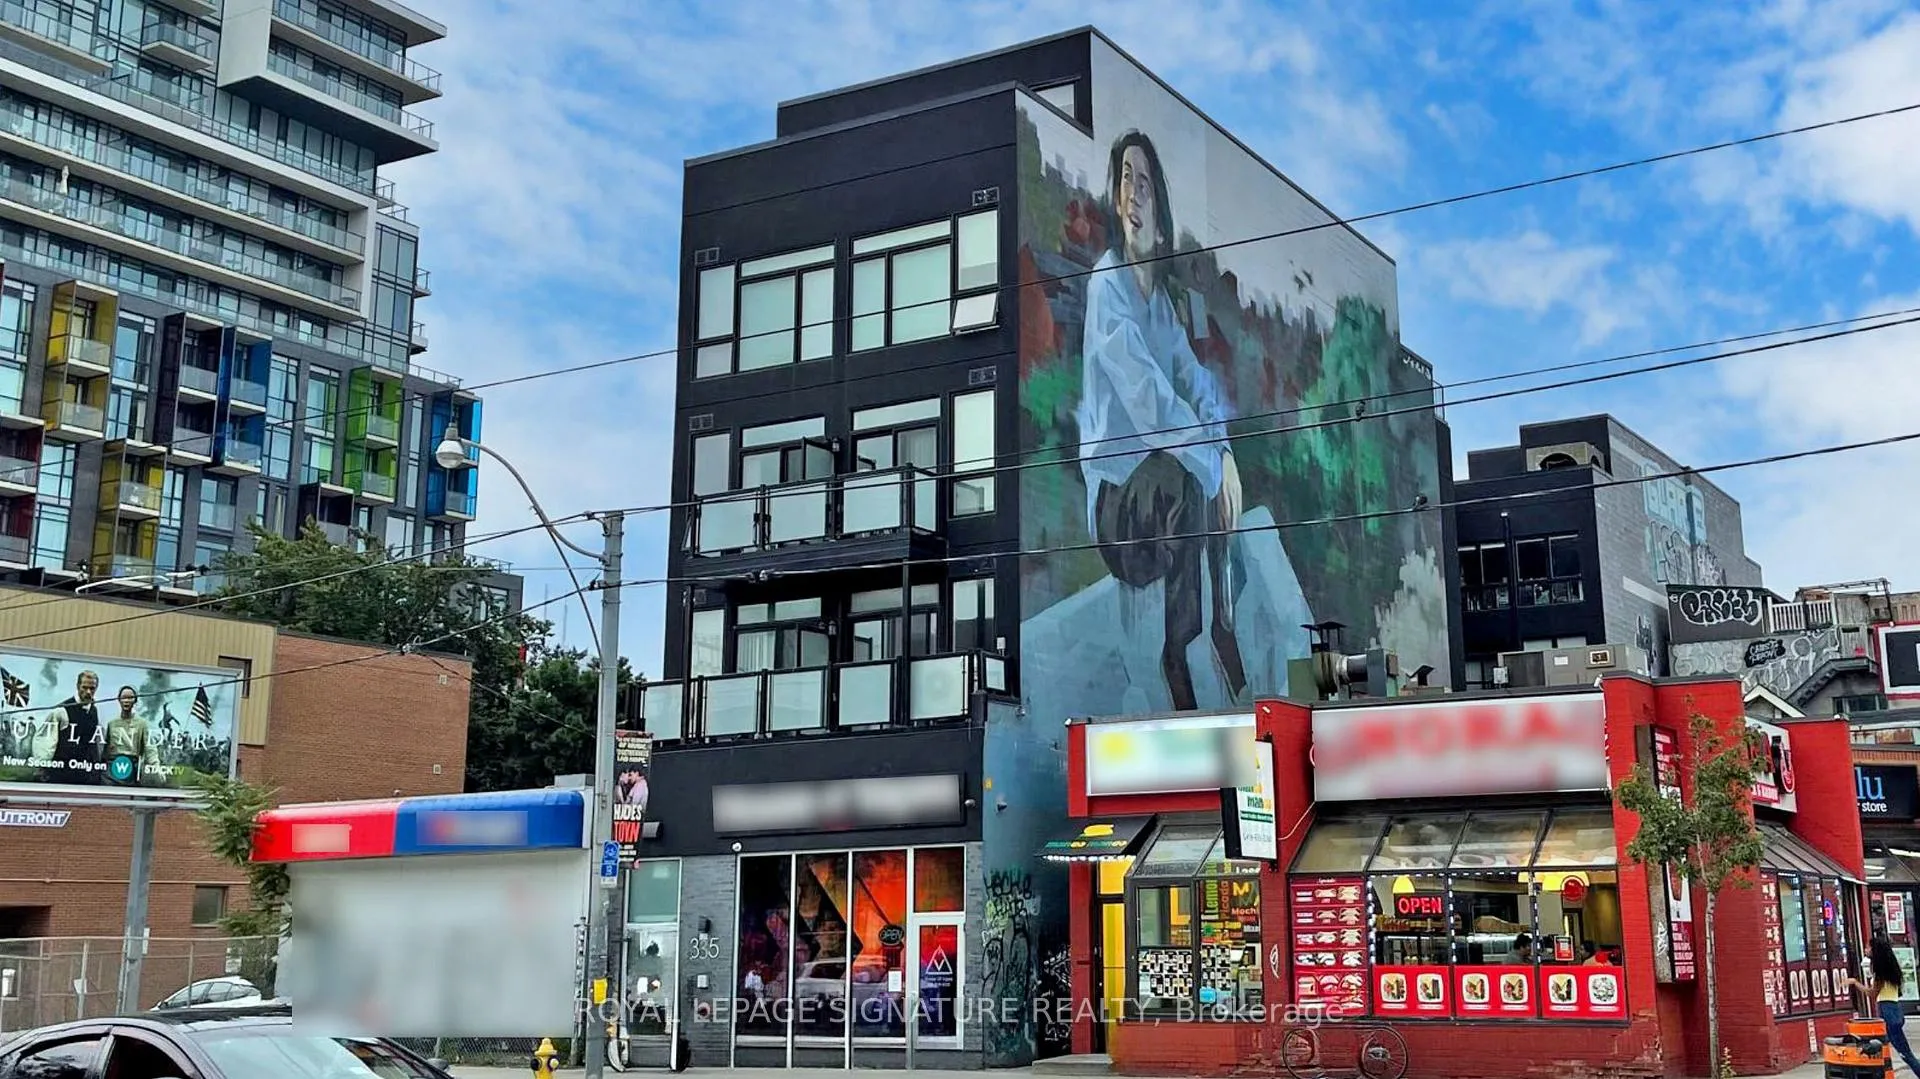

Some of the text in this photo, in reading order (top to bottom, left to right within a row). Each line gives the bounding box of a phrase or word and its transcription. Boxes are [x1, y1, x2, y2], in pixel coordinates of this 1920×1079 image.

[13, 721, 208, 750] UTLANDER
[3, 756, 27, 766] New
[28, 757, 65, 768] Season
[68, 759, 92, 772] Only
[94, 763, 107, 771] on
[115, 762, 130, 774] W
[1854, 767, 1886, 800] lu
[613, 803, 642, 821] HADES
[1861, 802, 1888, 812] store
[0, 810, 65, 825] UTFRONT
[1398, 896, 1443, 914] OPEN
[880, 928, 902, 941] OPEN
[690, 937, 720, 960] 335
